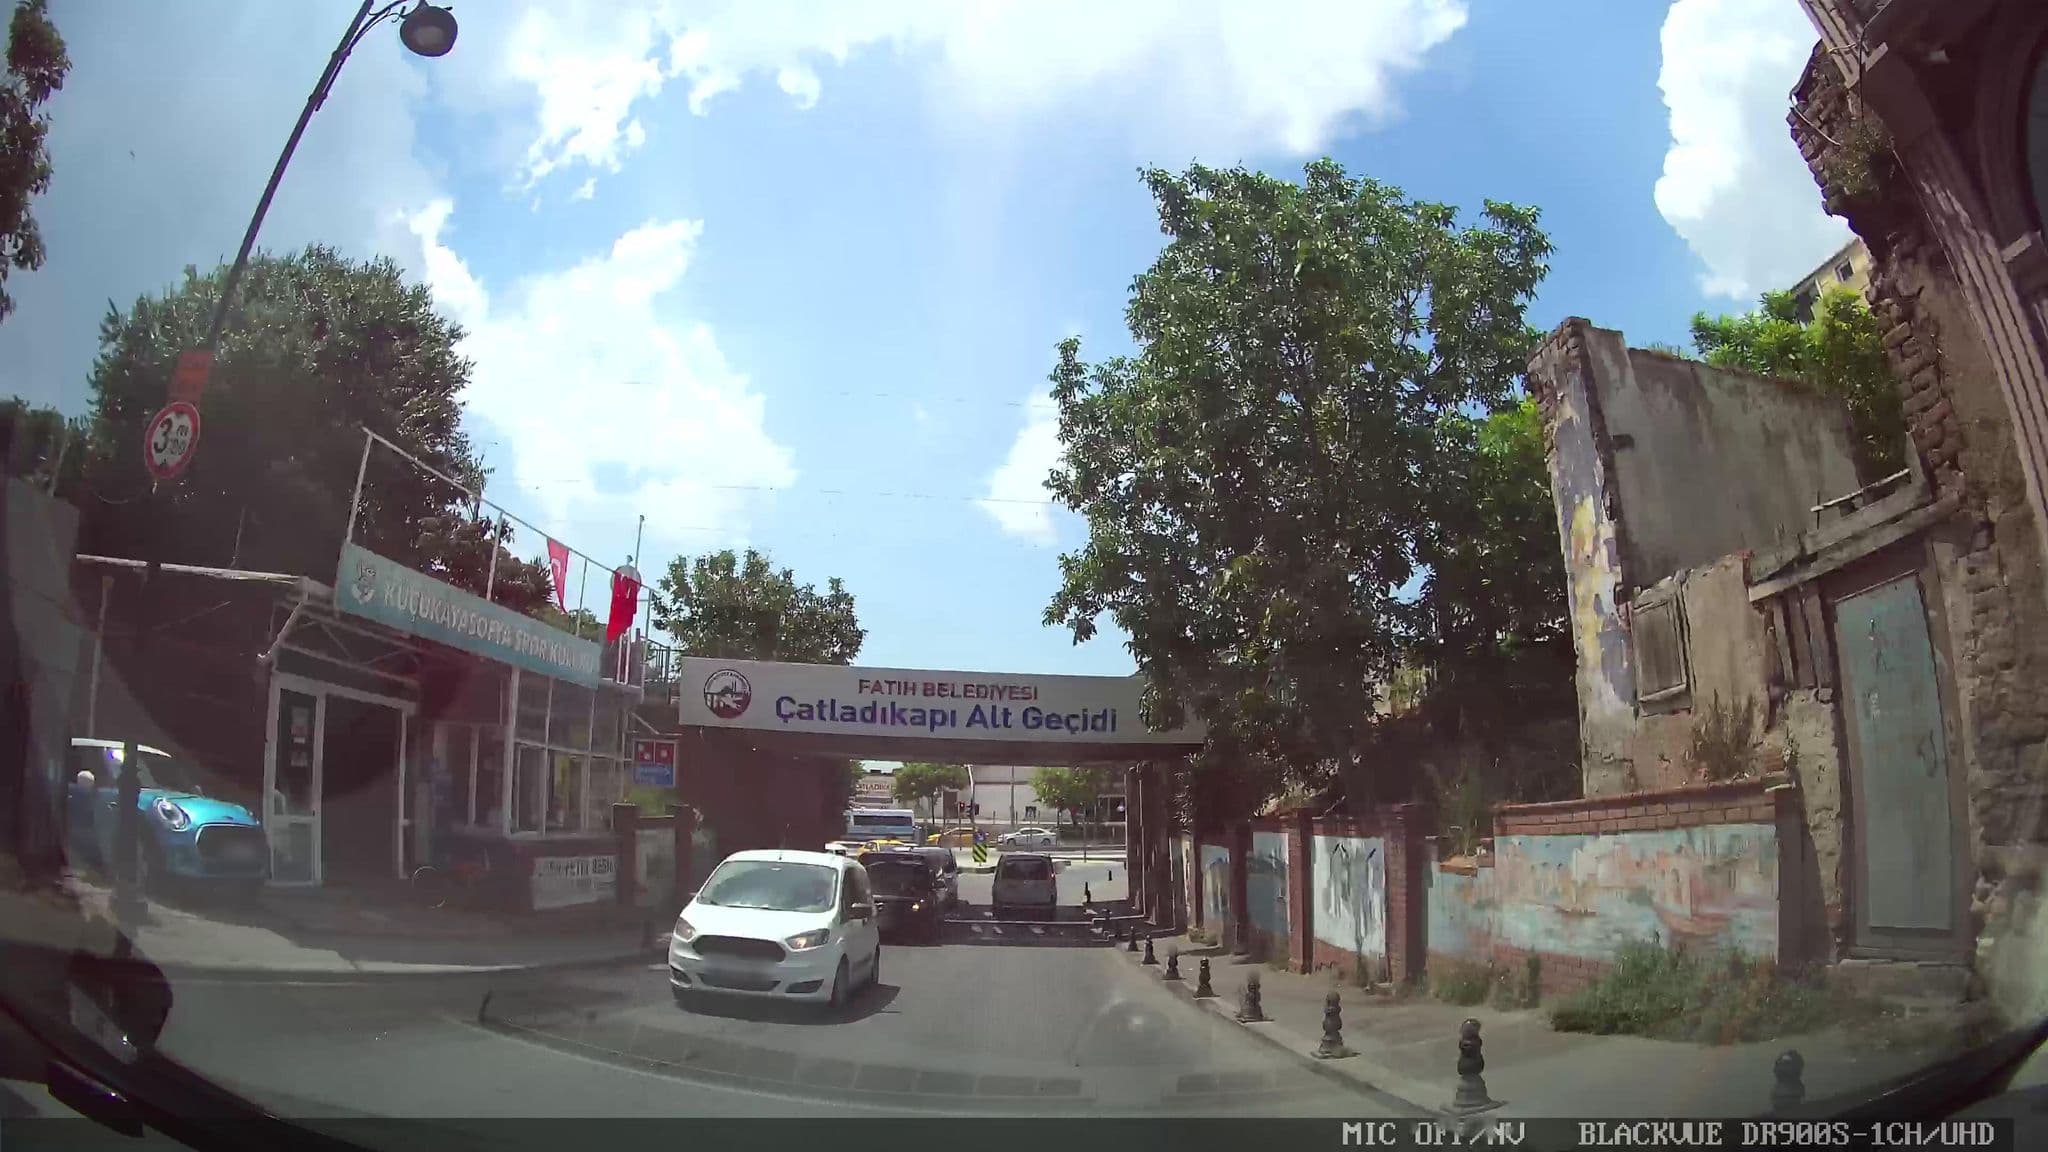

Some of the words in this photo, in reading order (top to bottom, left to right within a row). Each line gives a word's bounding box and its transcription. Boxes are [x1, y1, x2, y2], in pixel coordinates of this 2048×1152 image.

[775, 695, 957, 733] Çatladıkapı
[965, 703, 1012, 729] Alt
[1021, 706, 1117, 735] Geçidi
